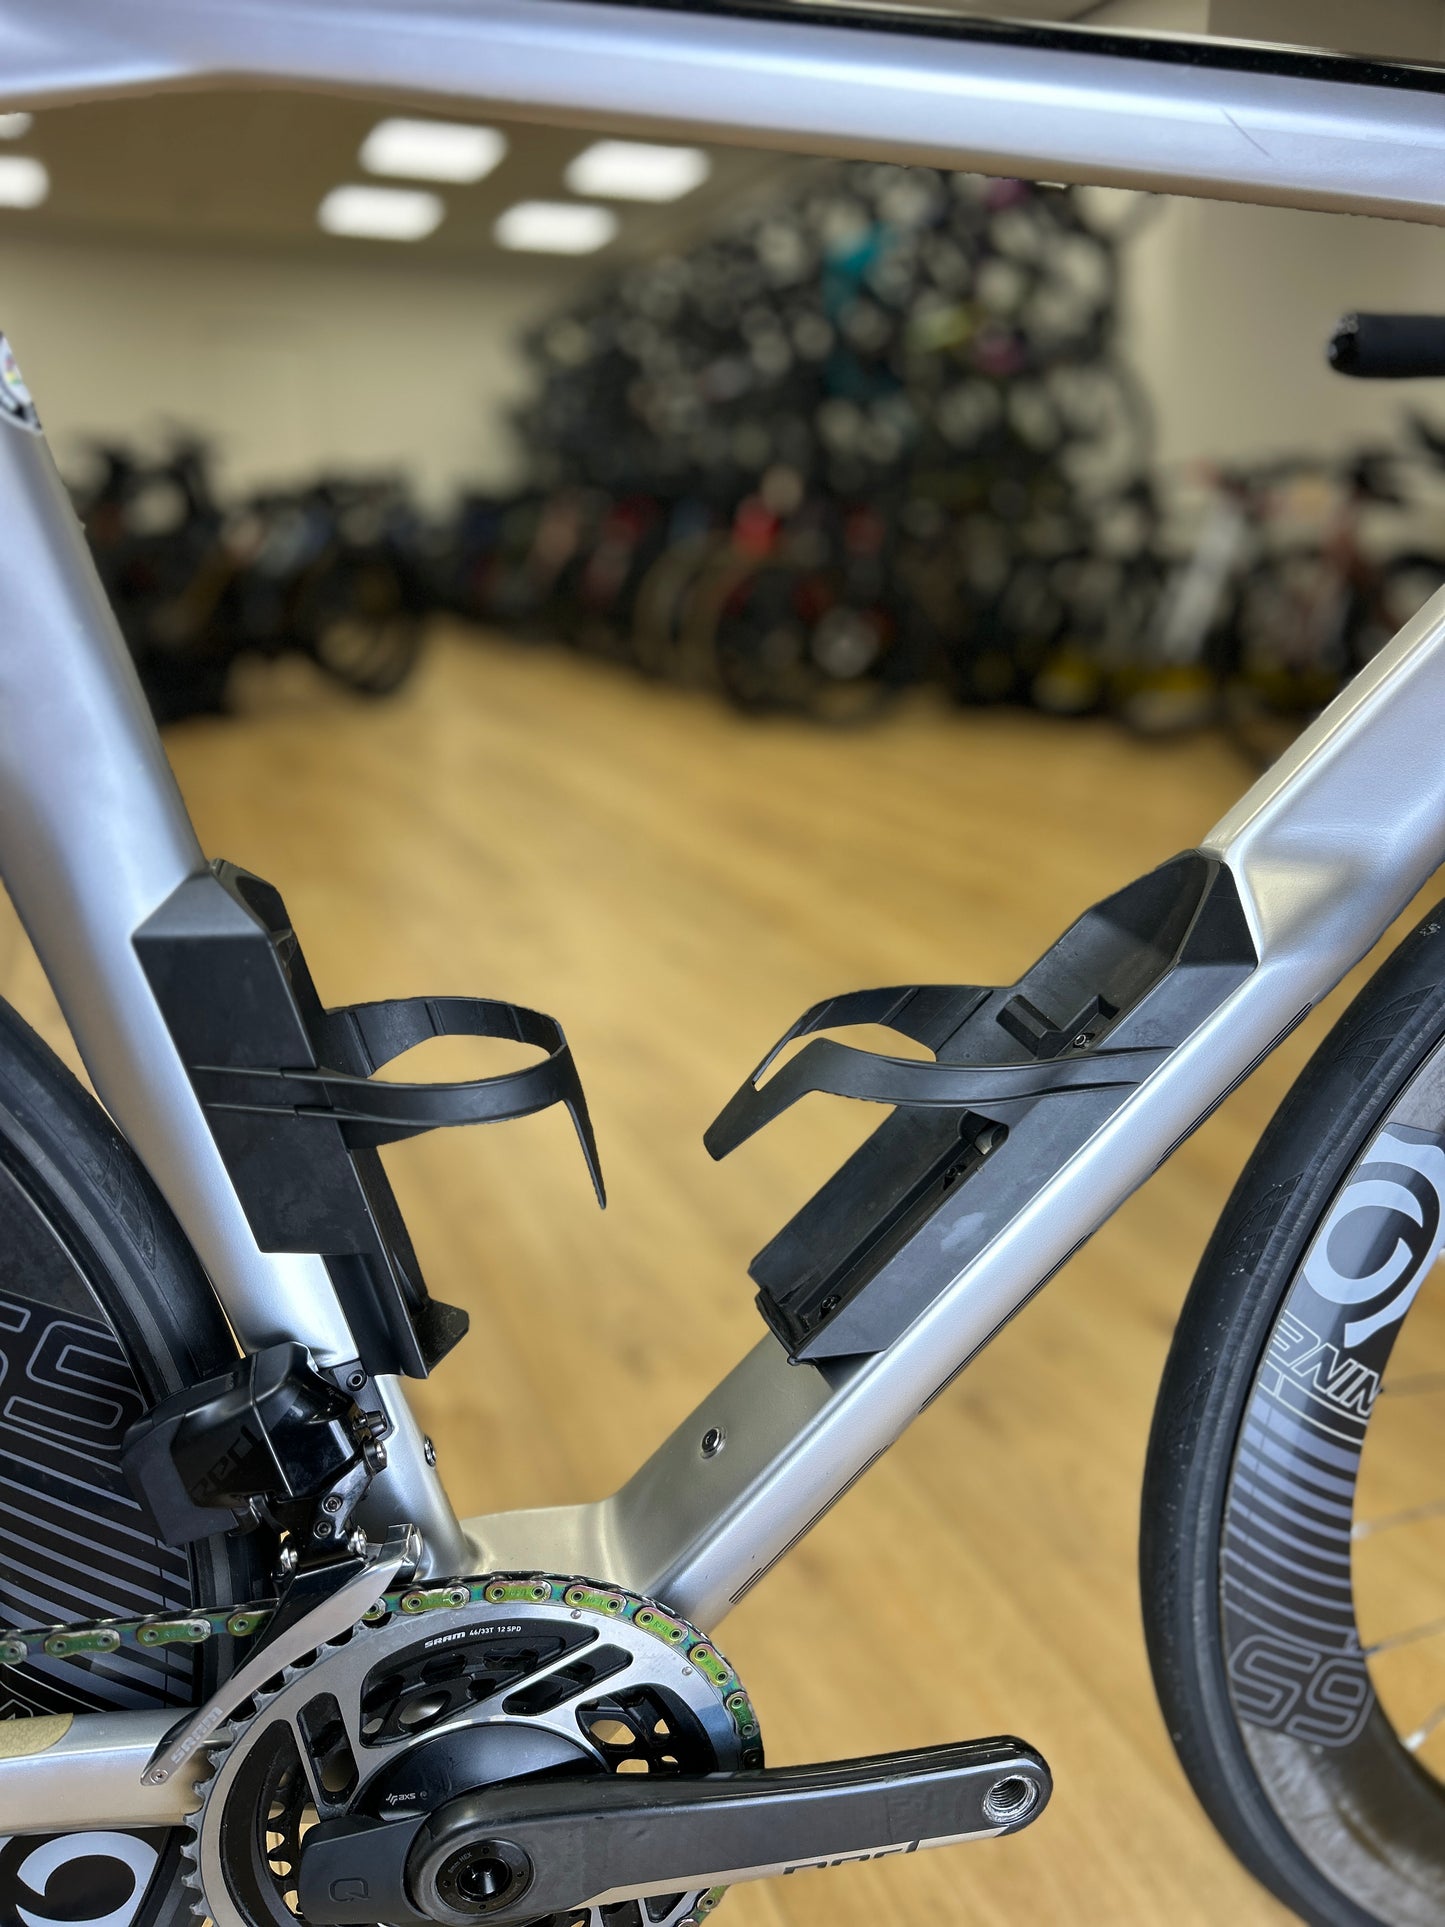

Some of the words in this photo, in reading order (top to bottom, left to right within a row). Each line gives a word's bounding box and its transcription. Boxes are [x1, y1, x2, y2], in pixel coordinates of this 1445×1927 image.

[1268, 1309, 1381, 1418] NINE
[424, 1631, 466, 1649] SRAM
[469, 1627, 494, 1636] 46/33T
[170, 1706, 224, 1765] SRAM
